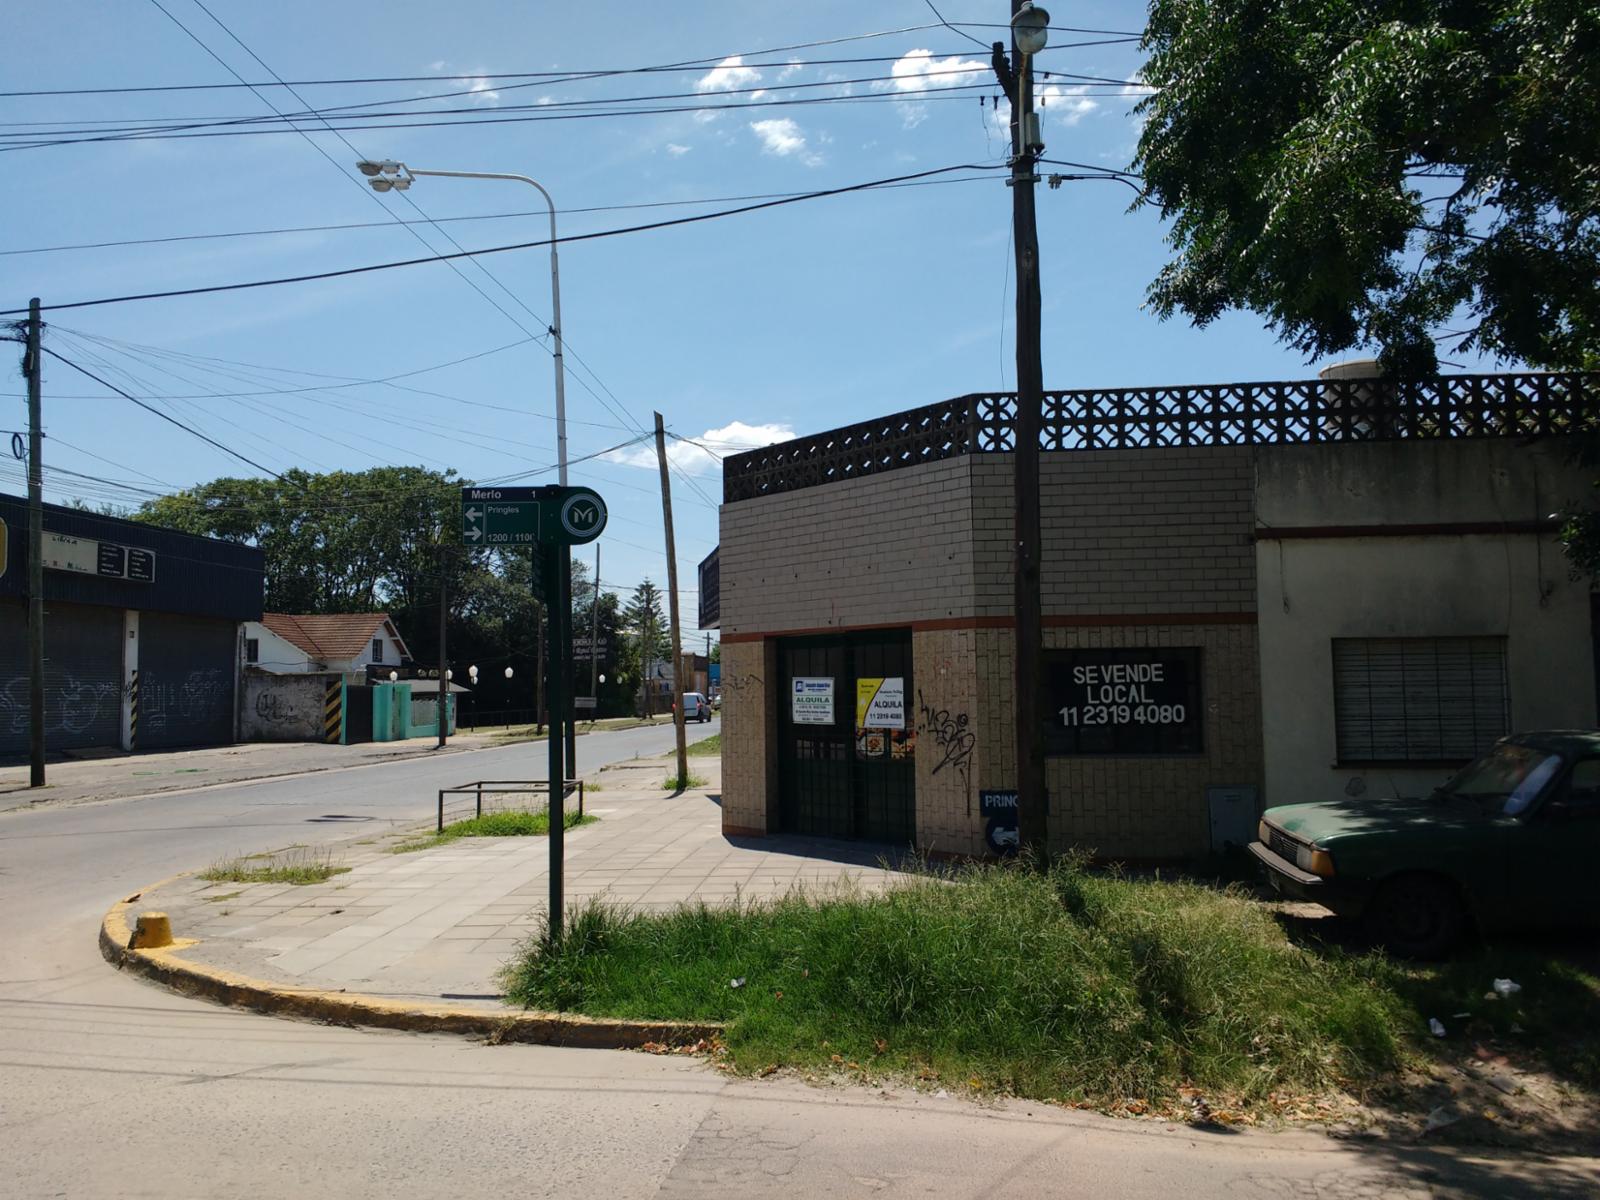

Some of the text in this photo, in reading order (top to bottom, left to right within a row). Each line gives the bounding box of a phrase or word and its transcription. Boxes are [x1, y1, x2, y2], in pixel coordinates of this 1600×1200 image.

[471, 490, 536, 499] Merlo 1
[487, 506, 520, 515] Pringles
[487, 533, 508, 542] 1200
[1073, 663, 1164, 684] SE VENDE
[1087, 684, 1154, 704] LOCAL
[874, 700, 902, 708] ALQUILA
[1059, 704, 1185, 726] 11 2319 4080
